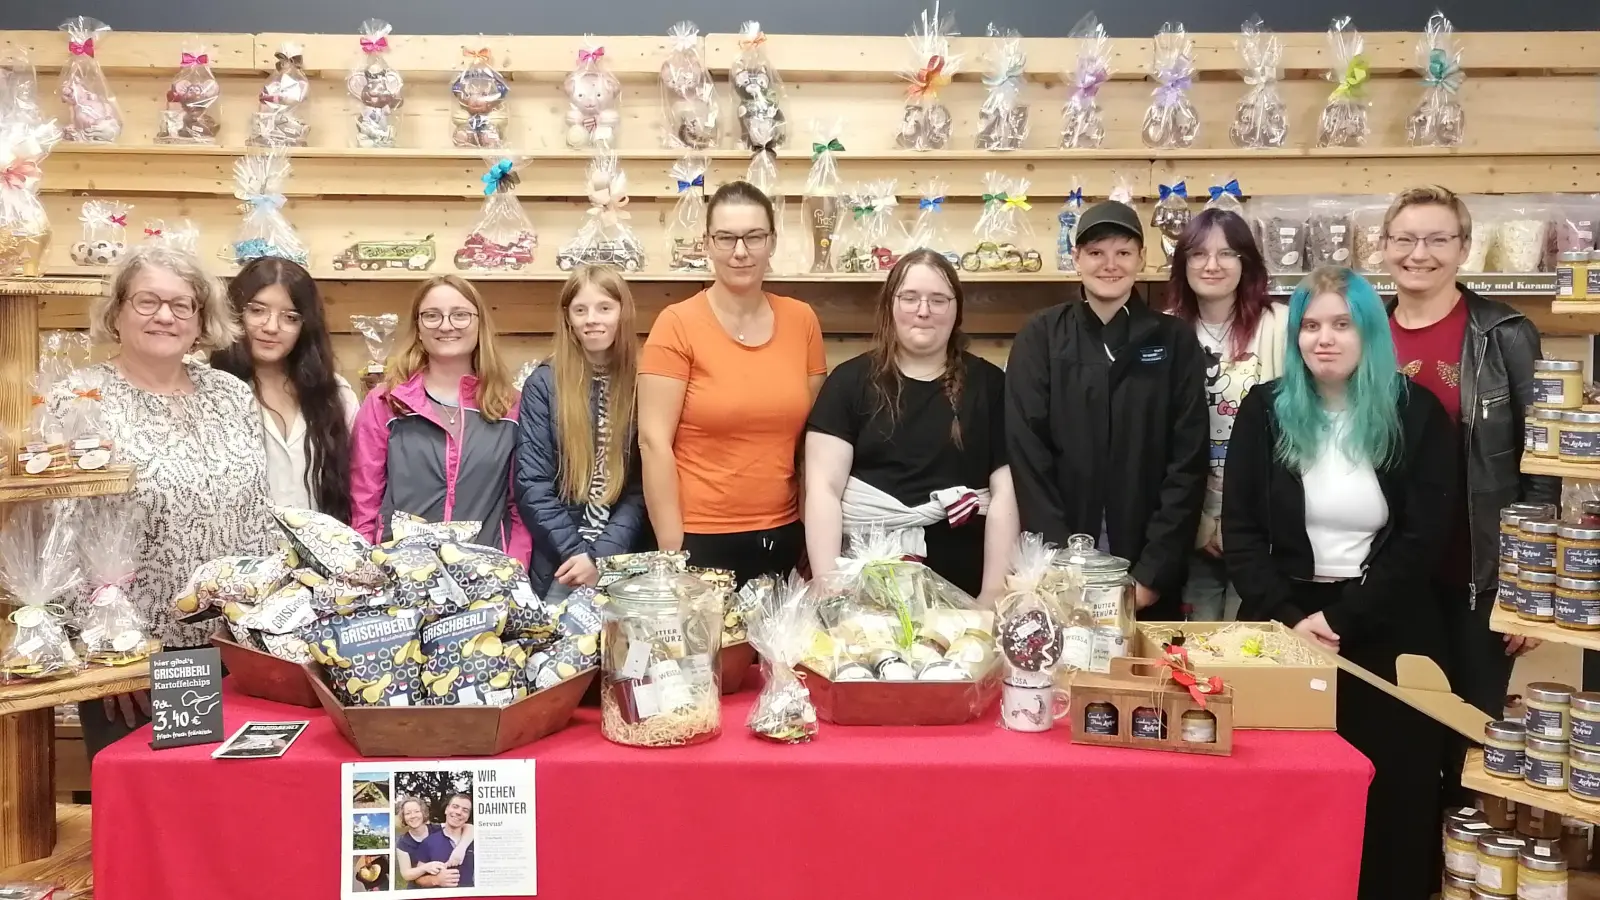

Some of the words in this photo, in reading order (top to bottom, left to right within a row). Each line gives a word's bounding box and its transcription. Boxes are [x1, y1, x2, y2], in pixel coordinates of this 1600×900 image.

[1466, 282, 1492, 291] Ruby
[1495, 282, 1514, 290] und
[1517, 282, 1556, 290] Karame
[340, 616, 417, 644] GRISCHBERLI
[423, 610, 487, 644] GRISCHBERLI
[153, 664, 210, 680] GRISCHBERLI
[154, 679, 211, 690] Kartoffelchips
[191, 715, 201, 726] €
[477, 769, 497, 782] WIR
[477, 785, 516, 799] STEHEN
[478, 802, 527, 815] DAHINTER
